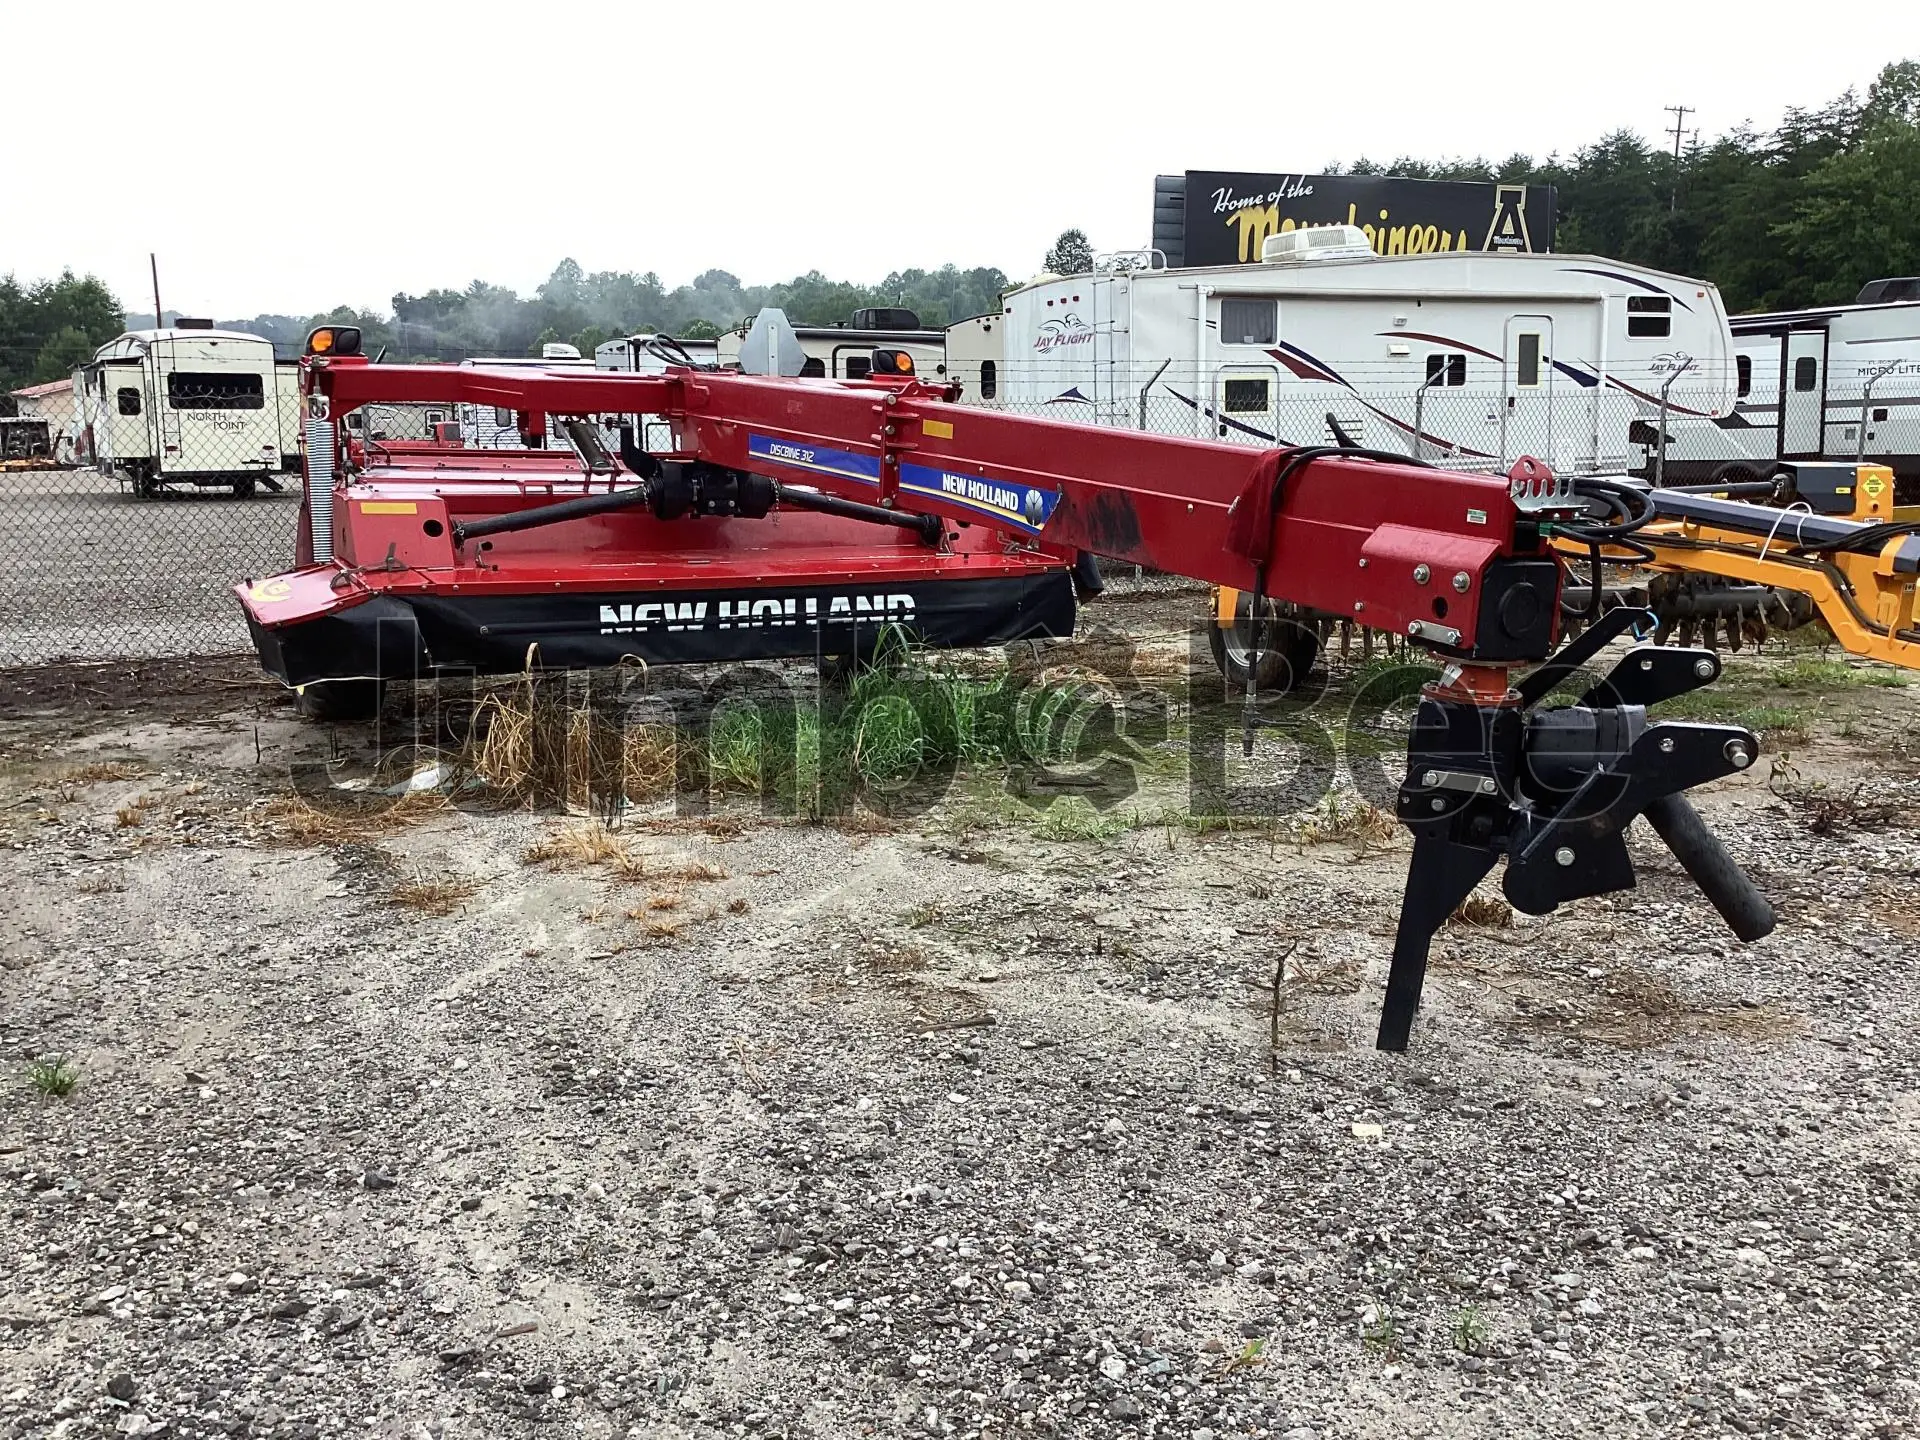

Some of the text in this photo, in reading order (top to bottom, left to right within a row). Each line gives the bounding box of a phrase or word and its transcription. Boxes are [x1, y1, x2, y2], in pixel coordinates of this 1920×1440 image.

[1211, 175, 1314, 213] Home of the
[1033, 333, 1095, 348] JAY FLIGHT
[1648, 363, 1667, 371] JAY
[187, 412, 227, 421] NORTH
[214, 421, 245, 431] POINT
[769, 443, 815, 463] DISCBINE 312
[942, 473, 1019, 512] NEW HOLLAND
[600, 594, 916, 635] NEW HOLLAND
